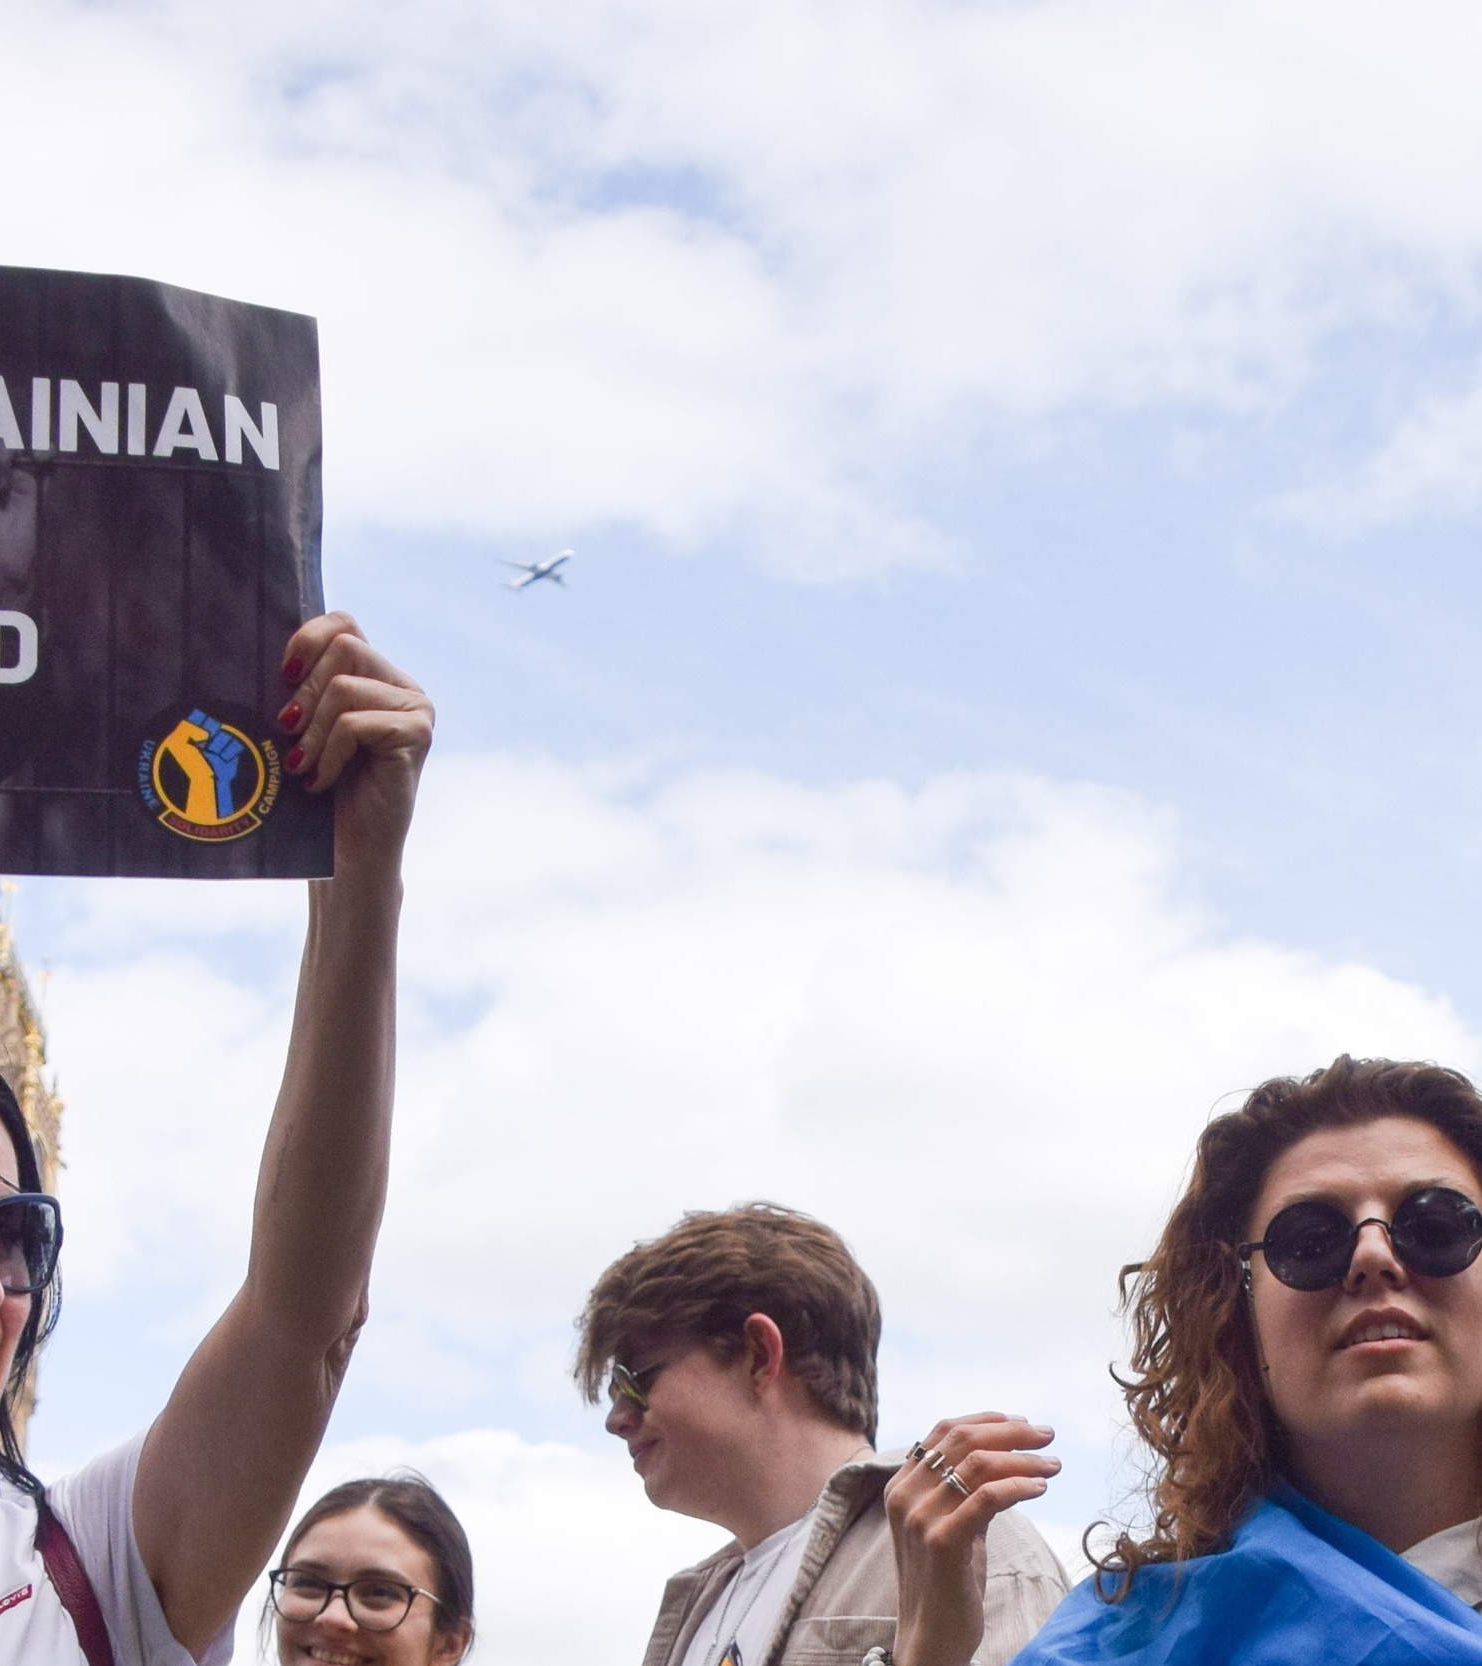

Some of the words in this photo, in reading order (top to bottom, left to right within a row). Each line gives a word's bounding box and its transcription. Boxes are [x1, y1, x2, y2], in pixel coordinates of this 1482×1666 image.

[137, 739, 159, 810] UKRAINE
[258, 738, 281, 814] CAMPAIGN
[168, 815, 251, 837] SOLIDARITY
